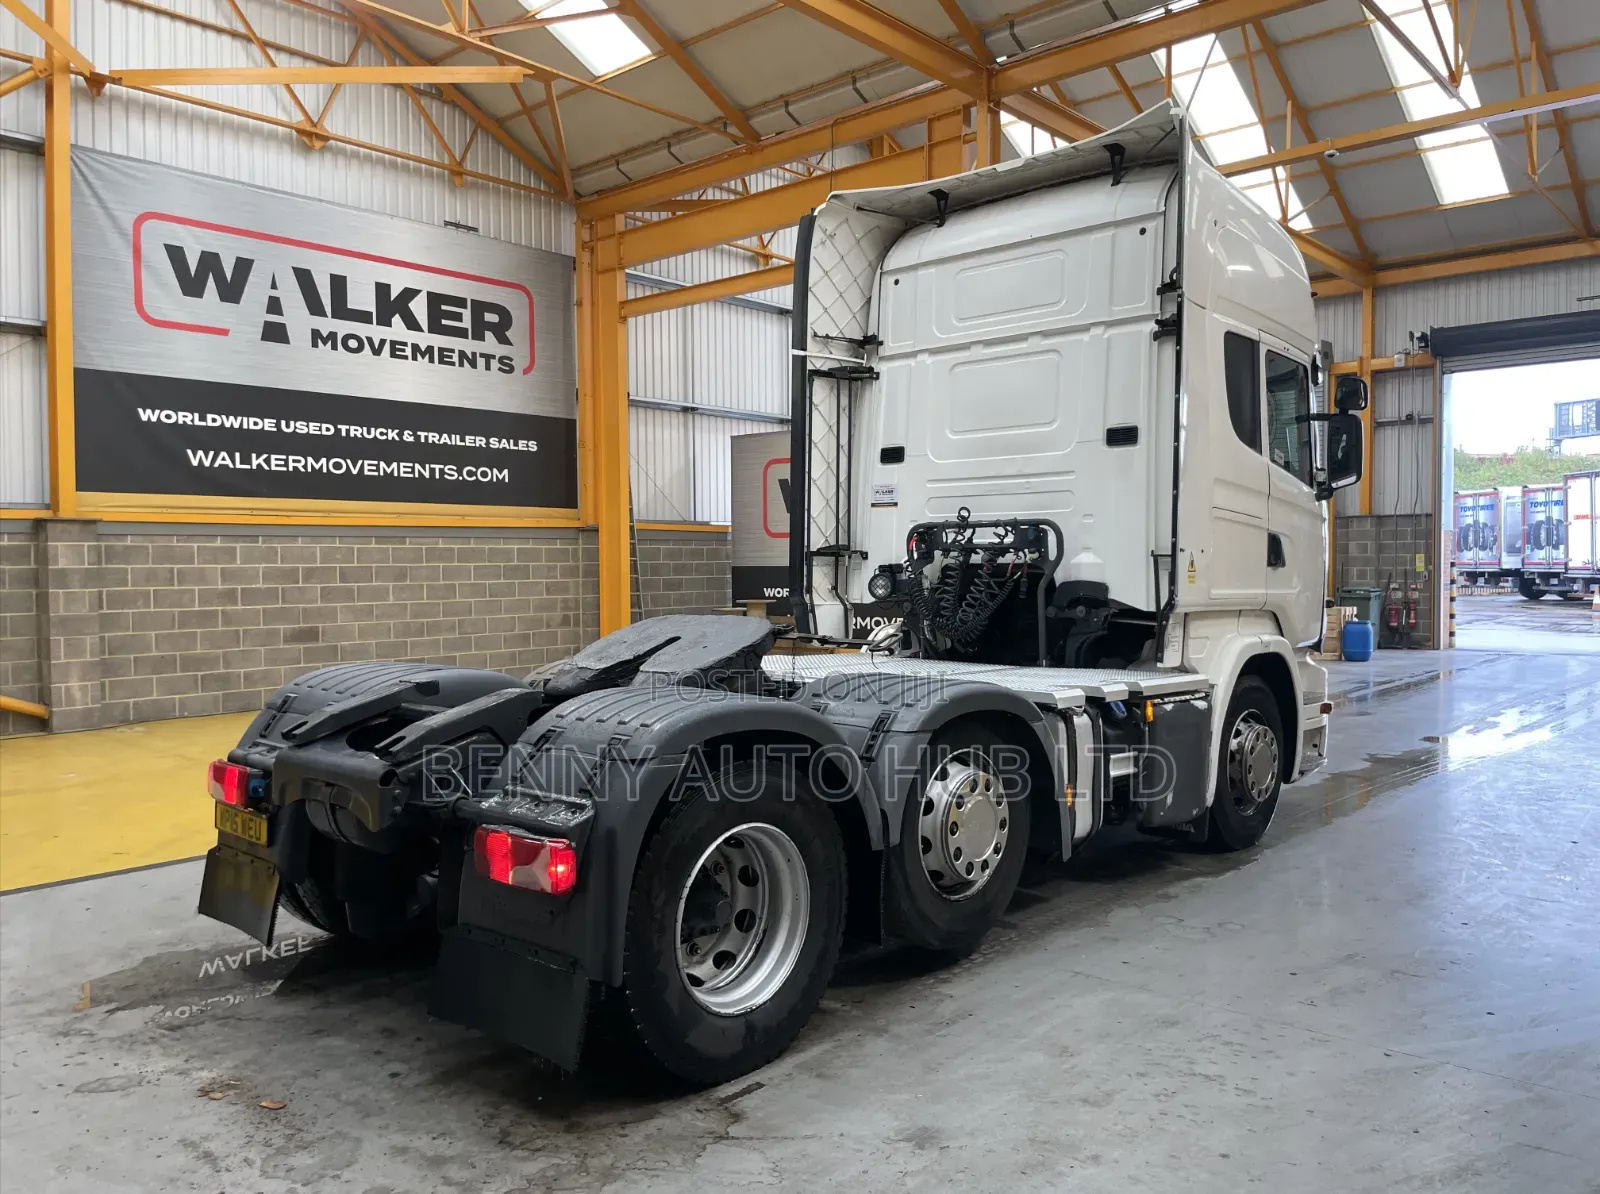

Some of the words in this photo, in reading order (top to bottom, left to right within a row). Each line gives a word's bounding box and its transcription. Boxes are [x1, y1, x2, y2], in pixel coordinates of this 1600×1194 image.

[164, 243, 514, 347] WALKER
[310, 328, 516, 375] MOVEMENTS
[137, 407, 278, 431] WORLDWIDE
[280, 420, 335, 436] USED
[337, 424, 400, 441] TRUCK
[402, 430, 415, 442] &
[417, 431, 487, 448] TRAILER
[489, 437, 538, 452] SALES
[186, 449, 509, 483] WALKERMOVEMENTS.COM
